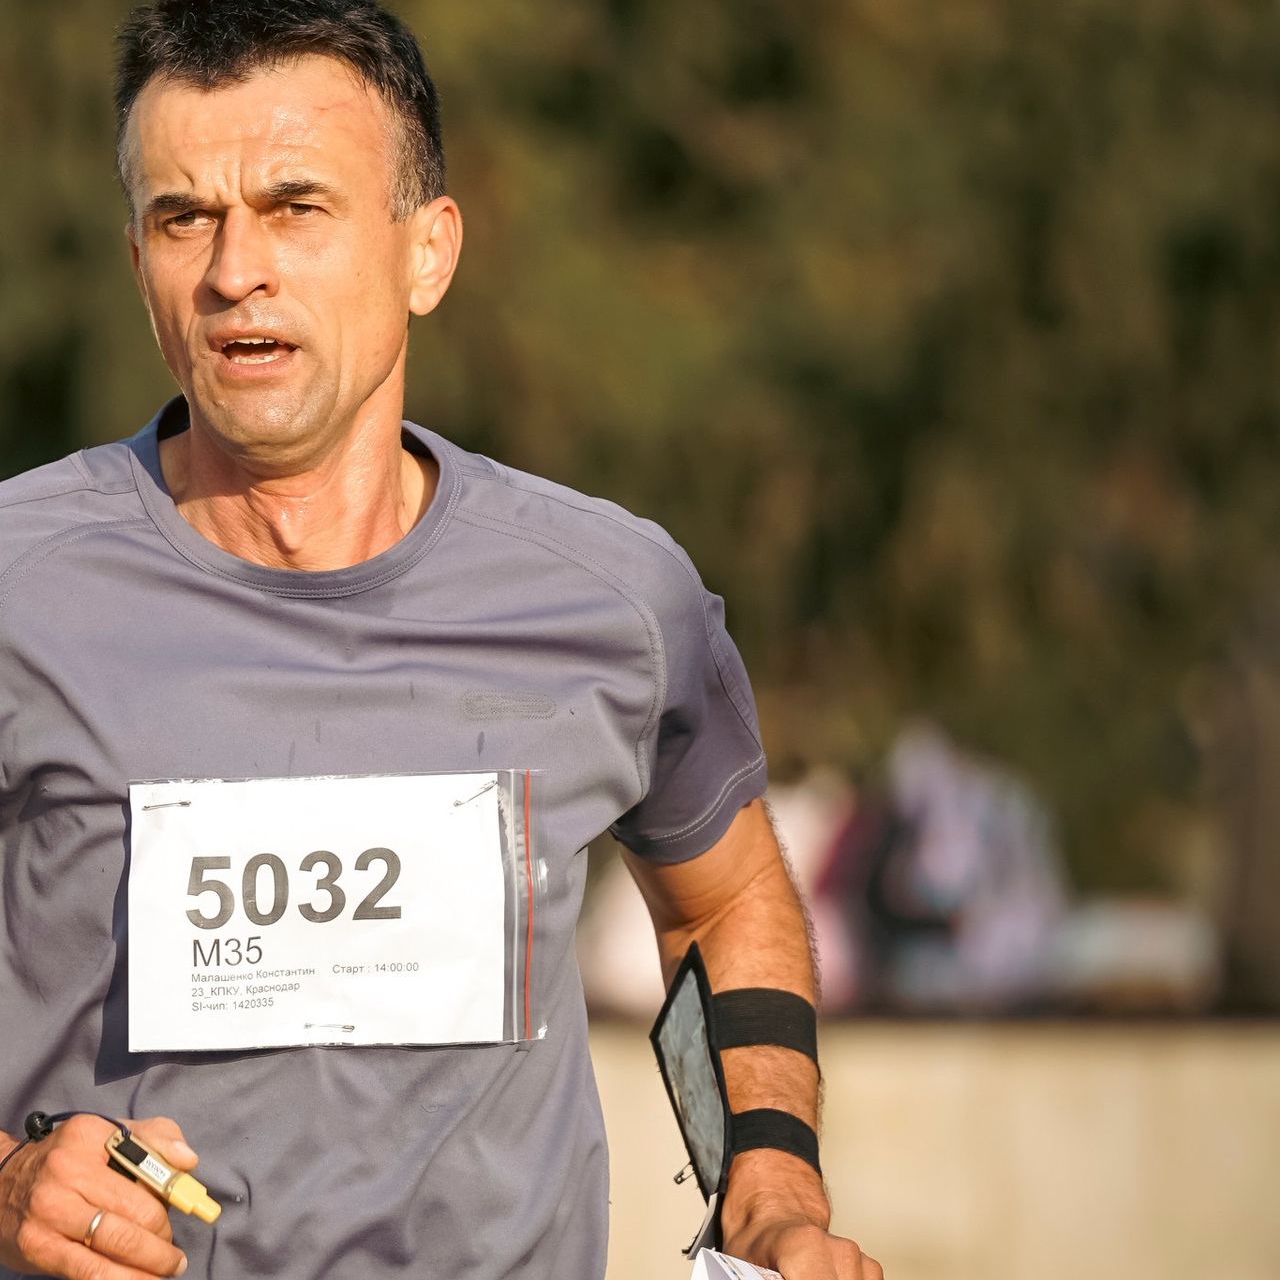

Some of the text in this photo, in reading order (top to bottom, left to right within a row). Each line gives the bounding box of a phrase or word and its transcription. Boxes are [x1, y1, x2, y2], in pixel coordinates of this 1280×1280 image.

[185, 847, 402, 930] 5032
[191, 968, 316, 983] Малашенко Константин
[332, 964, 364, 975] Старт
[375, 962, 420, 972] 14:00:00
[245, 982, 300, 996] Краснодар
[233, 996, 274, 1010] 1420335
